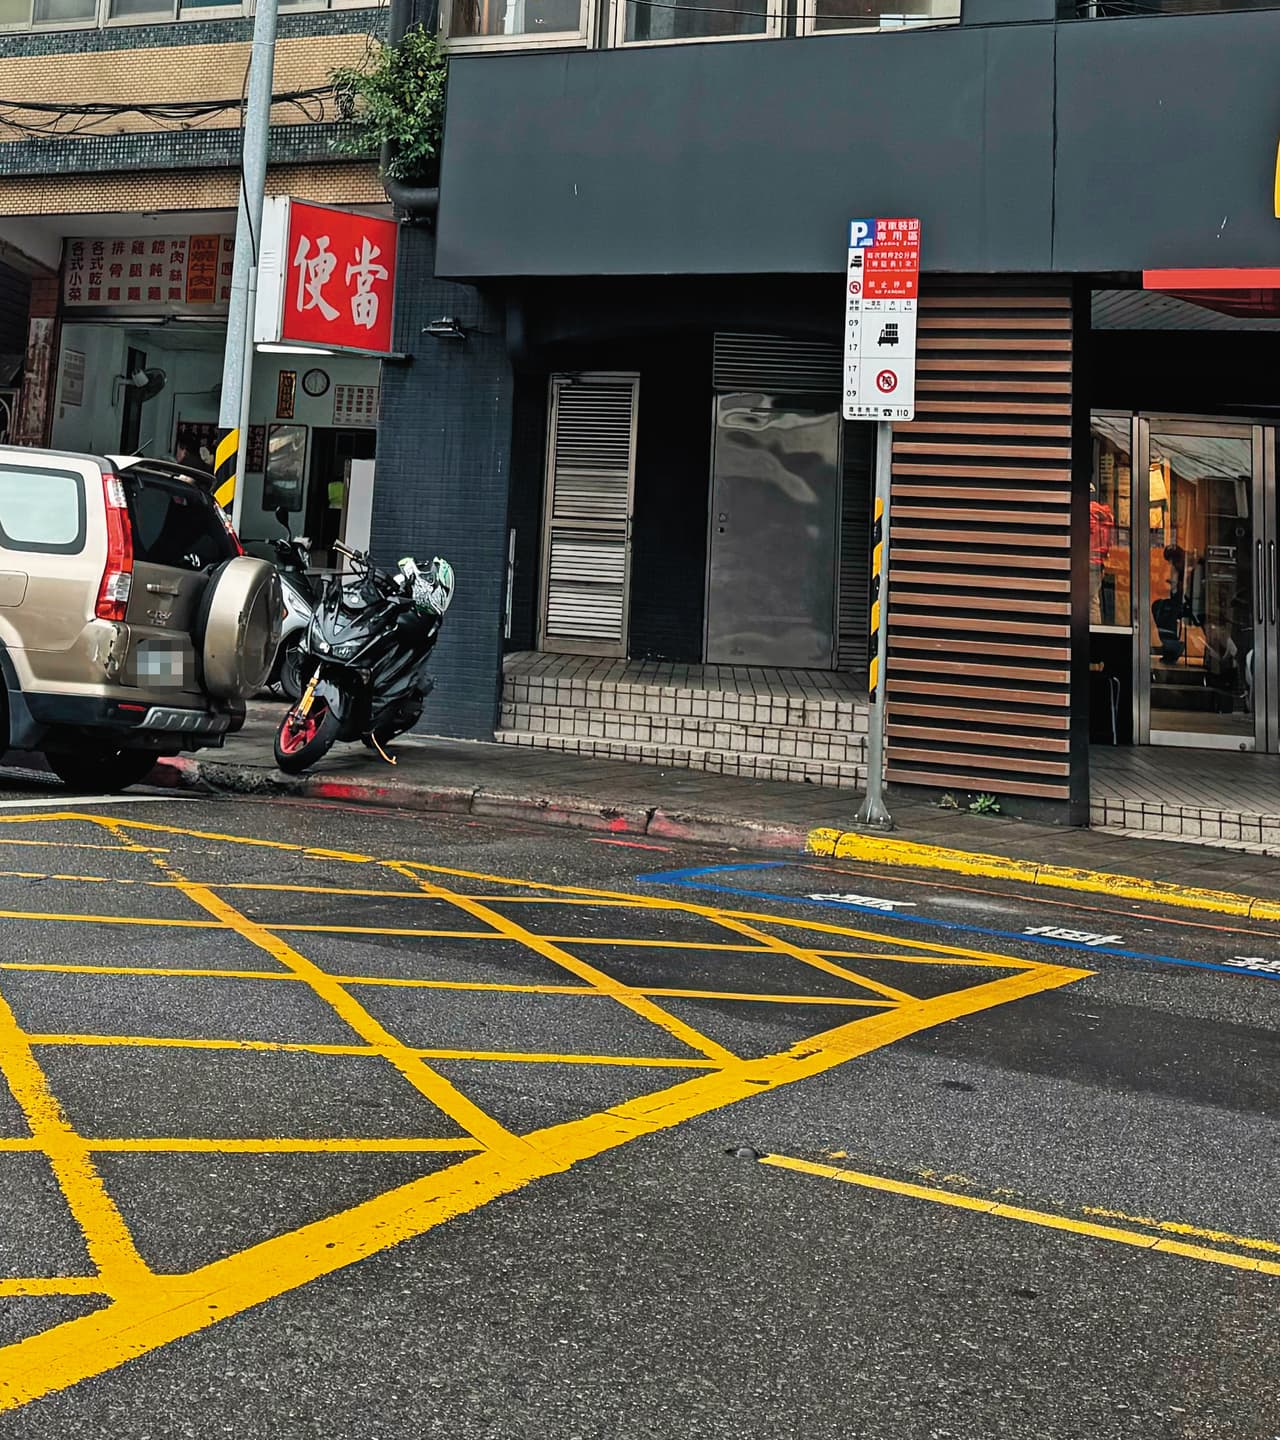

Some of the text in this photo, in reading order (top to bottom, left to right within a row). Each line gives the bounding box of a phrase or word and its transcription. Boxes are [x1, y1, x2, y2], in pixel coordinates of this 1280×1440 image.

[849, 221, 869, 247] P
[876, 231, 918, 241] 專用區
[68, 241, 85, 302] 各式小菜
[107, 240, 126, 301] 排骨麵
[293, 233, 389, 330] 便當
[848, 319, 859, 327] 09
[849, 343, 858, 351] 17
[896, 409, 909, 417] 110
